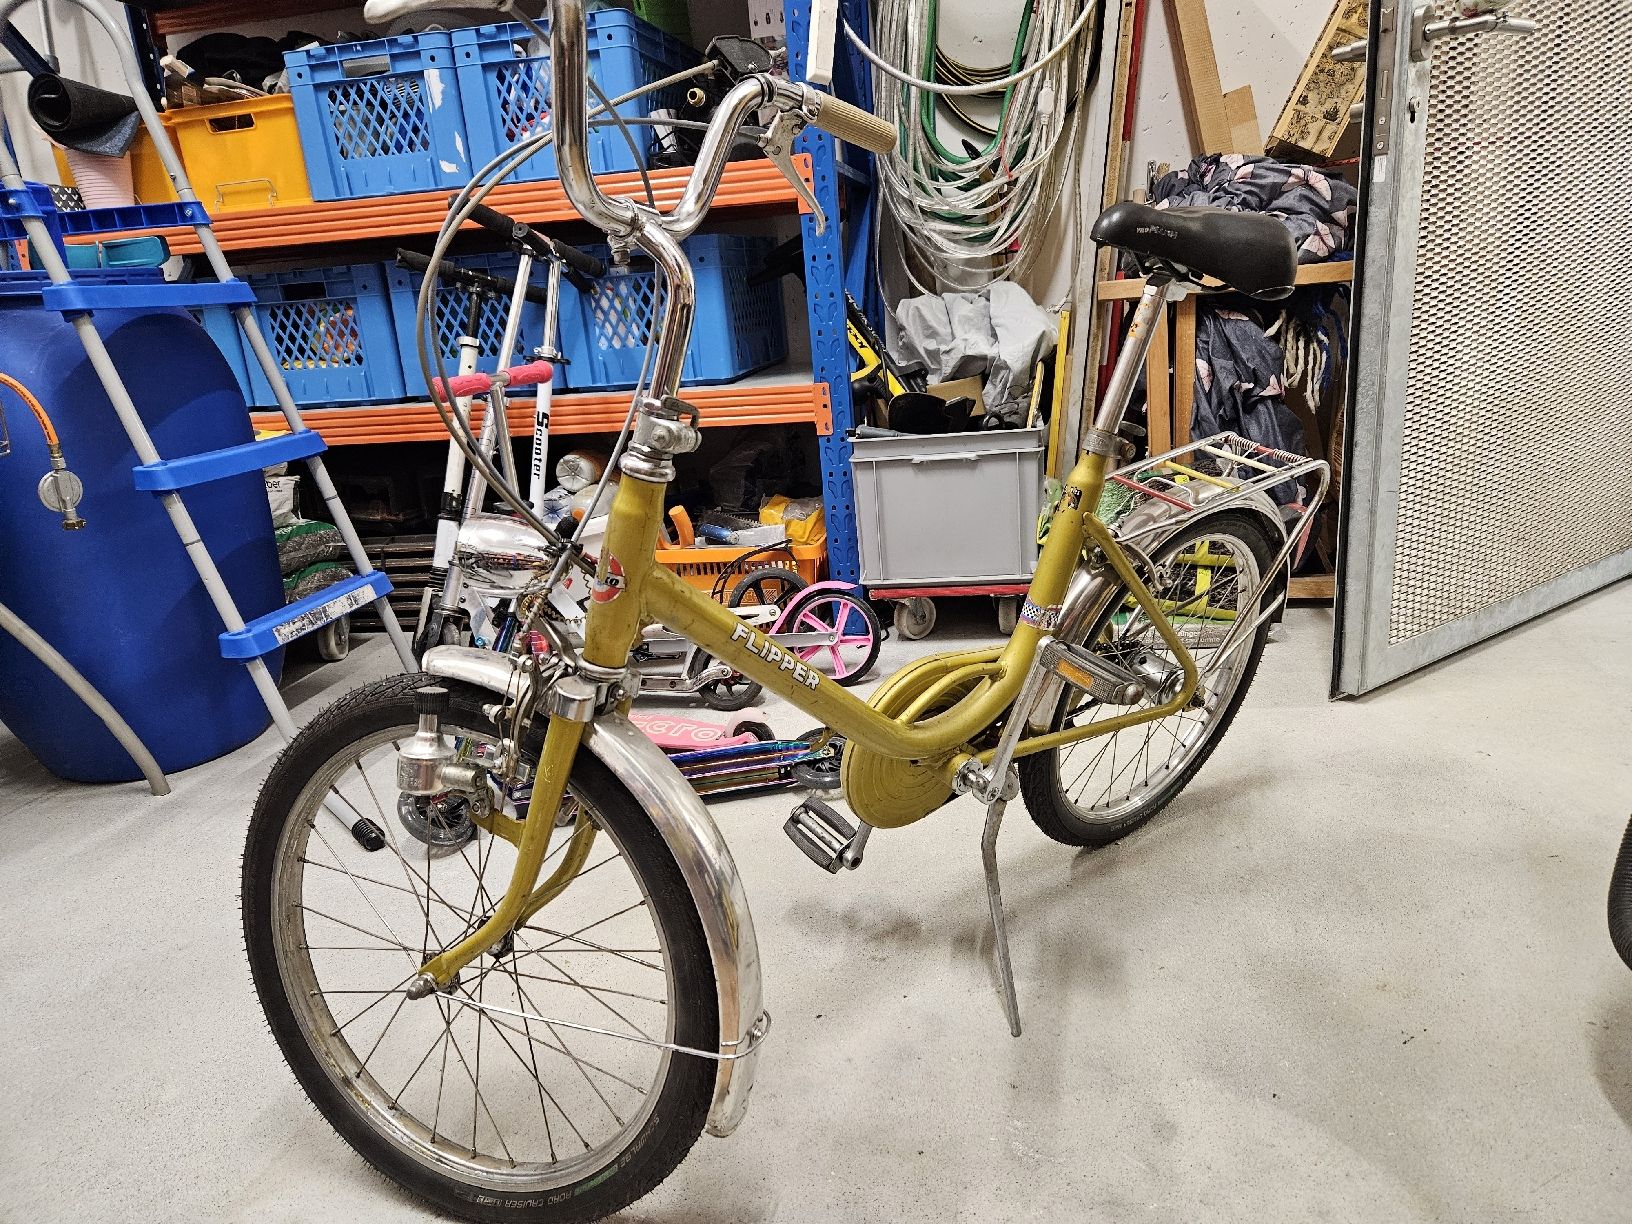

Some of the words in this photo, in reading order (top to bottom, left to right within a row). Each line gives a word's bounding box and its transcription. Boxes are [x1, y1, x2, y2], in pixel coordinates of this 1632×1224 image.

[533, 410, 549, 479] Scooter
[730, 622, 821, 691] FLIPPER
[633, 719, 722, 742] cro
[504, 1198, 545, 1209] CRUISER
[547, 1191, 573, 1205] ROAD
